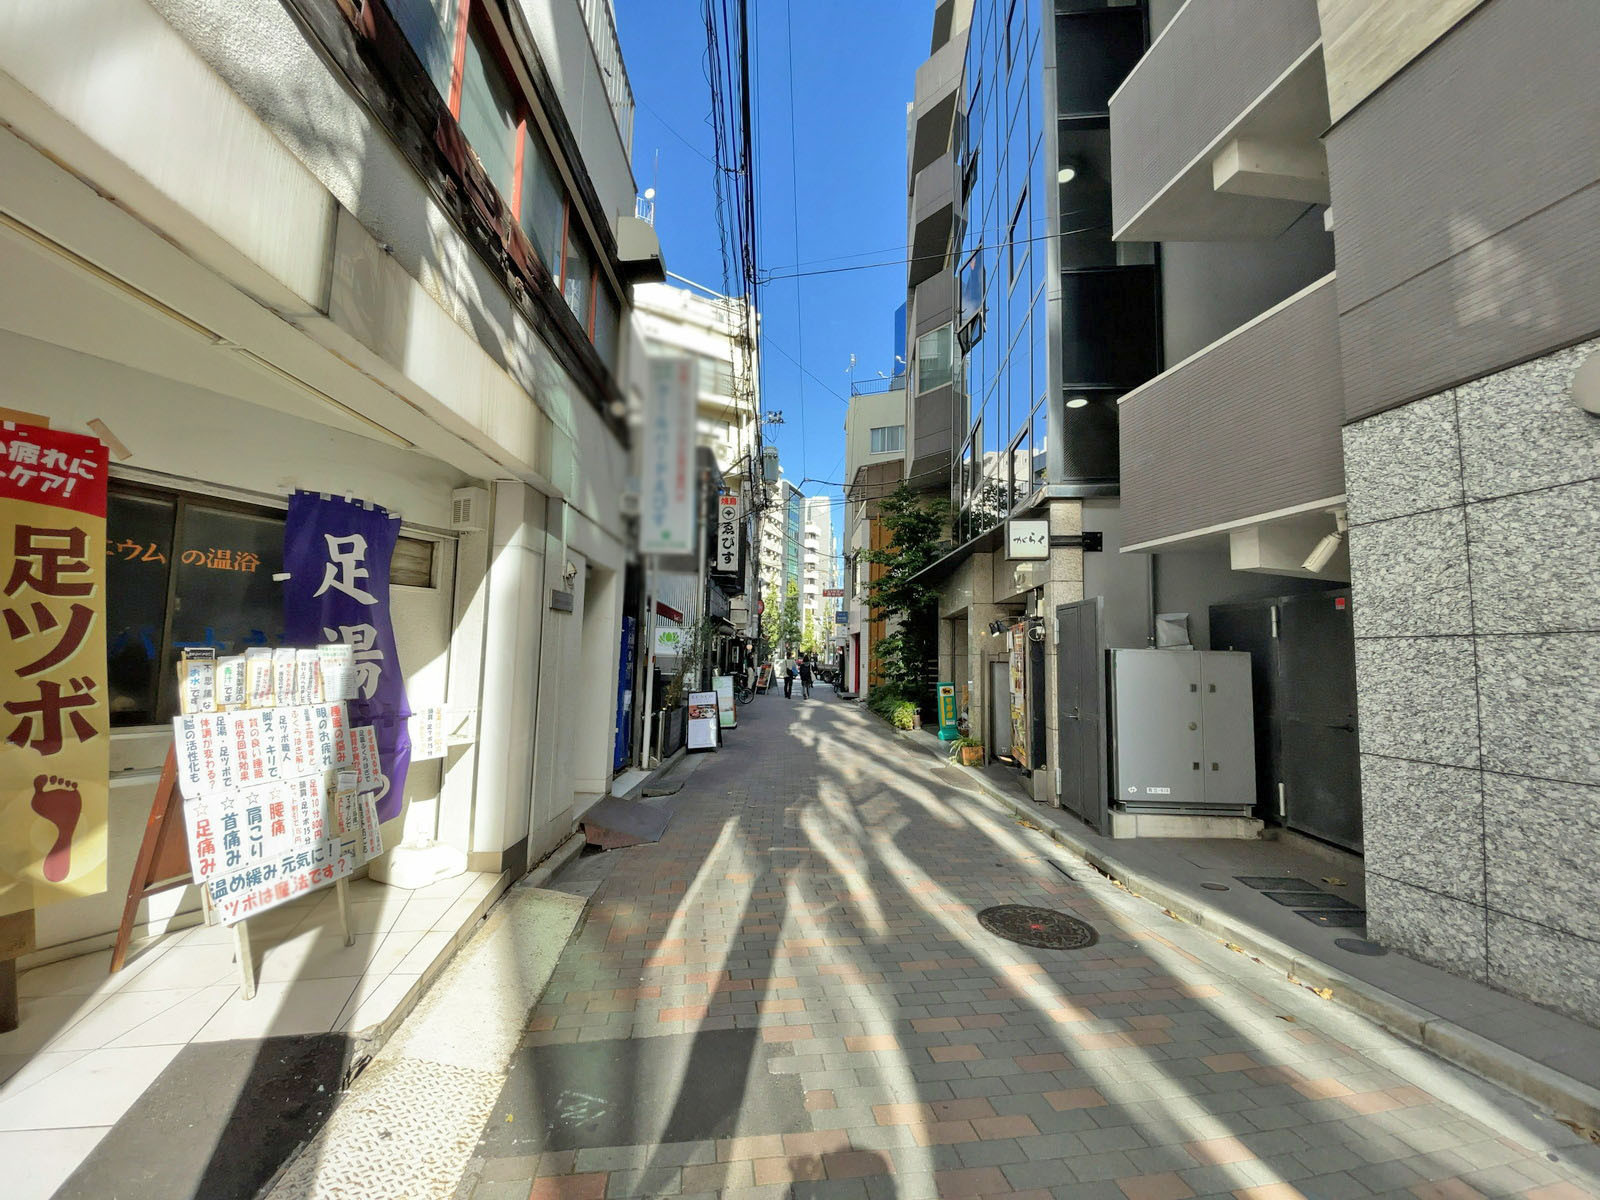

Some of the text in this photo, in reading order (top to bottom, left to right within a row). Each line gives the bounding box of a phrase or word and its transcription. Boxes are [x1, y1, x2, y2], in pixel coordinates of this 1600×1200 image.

[721, 521, 735, 564] ゑびす
[2, 525, 99, 756] 足ツボ
[313, 533, 391, 802] 足湯
[315, 706, 332, 766] 眼のお疲れ
[196, 818, 215, 876] 足痛み
[221, 812, 241, 867] 首痛み
[246, 805, 263, 858] 肩こり
[269, 801, 286, 838] 腰痛
